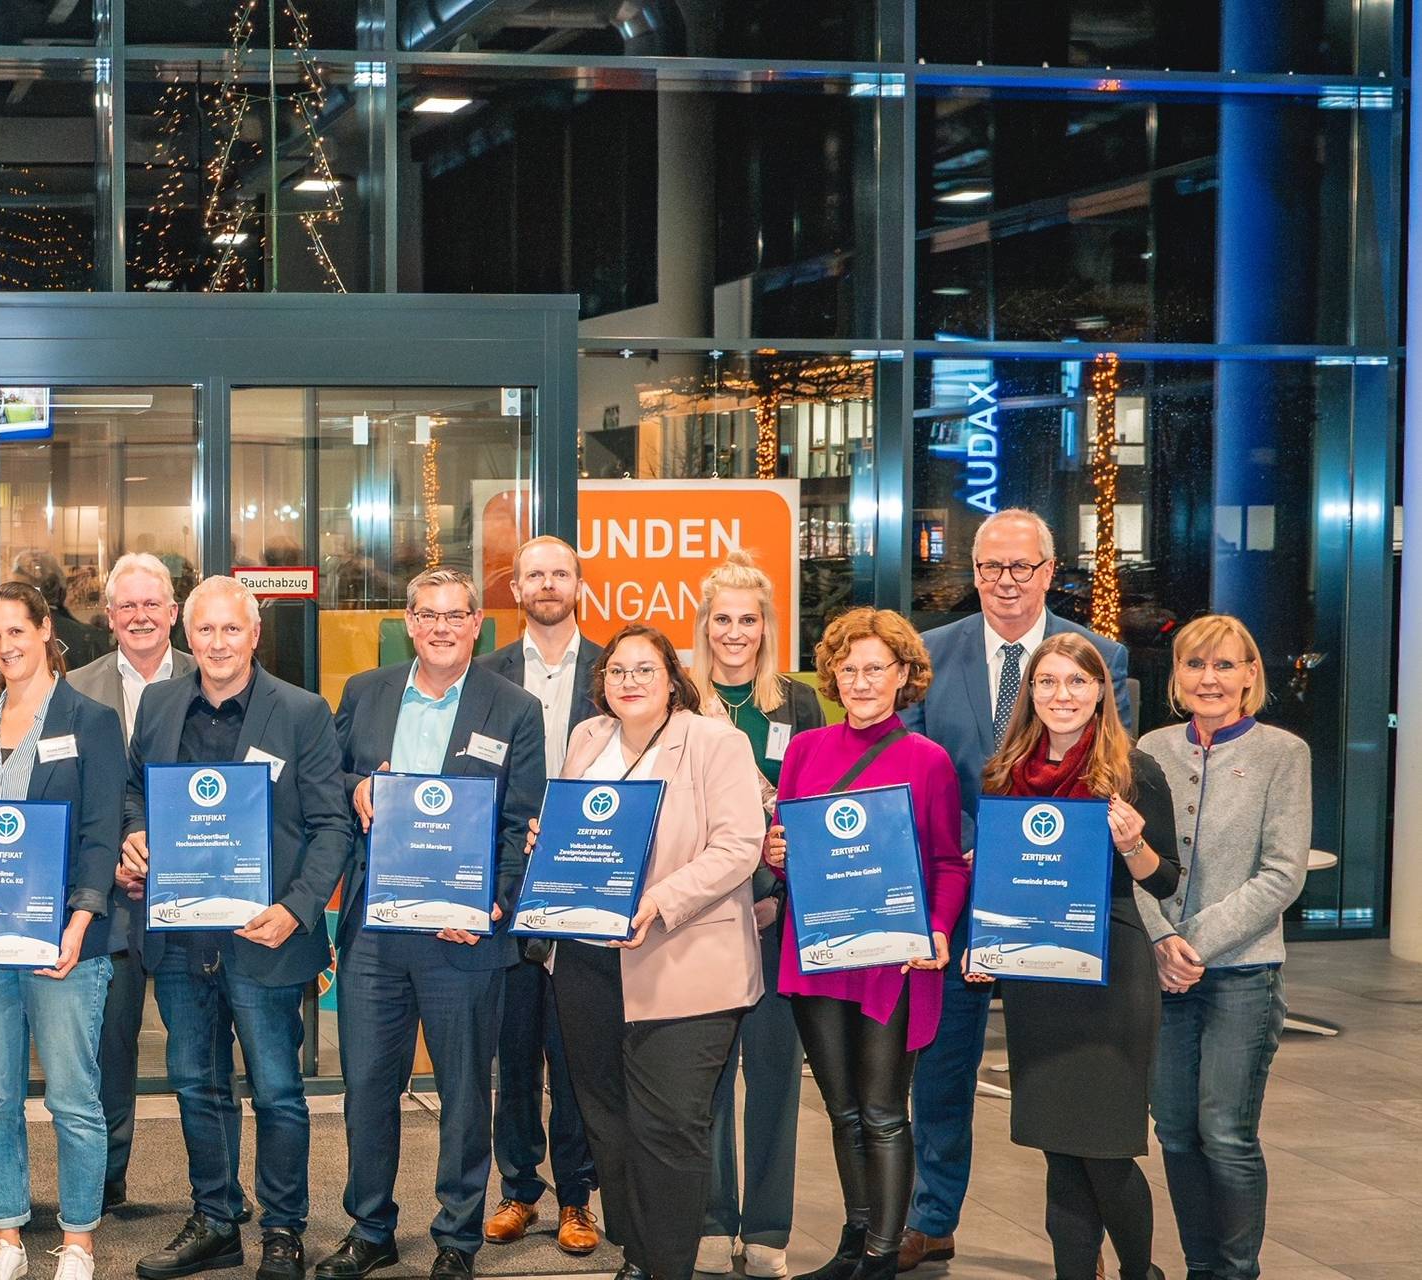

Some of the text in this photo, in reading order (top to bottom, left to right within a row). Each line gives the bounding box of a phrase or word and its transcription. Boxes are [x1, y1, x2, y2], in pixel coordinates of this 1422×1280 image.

[966, 381, 999, 513] AUDAX
[577, 518, 740, 559] UNDEN
[240, 577, 308, 590] Rauchabzug
[581, 580, 700, 621] NGAN
[190, 814, 226, 822] ZERTIFIKAT
[414, 821, 450, 830] ZERTIFIKAT
[831, 844, 871, 857] ZERTIFIKAT
[1021, 853, 1062, 862] ZERTIFIKAT
[863, 867, 882, 876] GmbH
[1012, 877, 1043, 886] Gemeinde
[159, 908, 181, 918] WFG
[376, 908, 398, 918] WFG
[526, 915, 547, 925] WFG
[809, 949, 834, 961] WFG
[979, 953, 1003, 964] WFG
